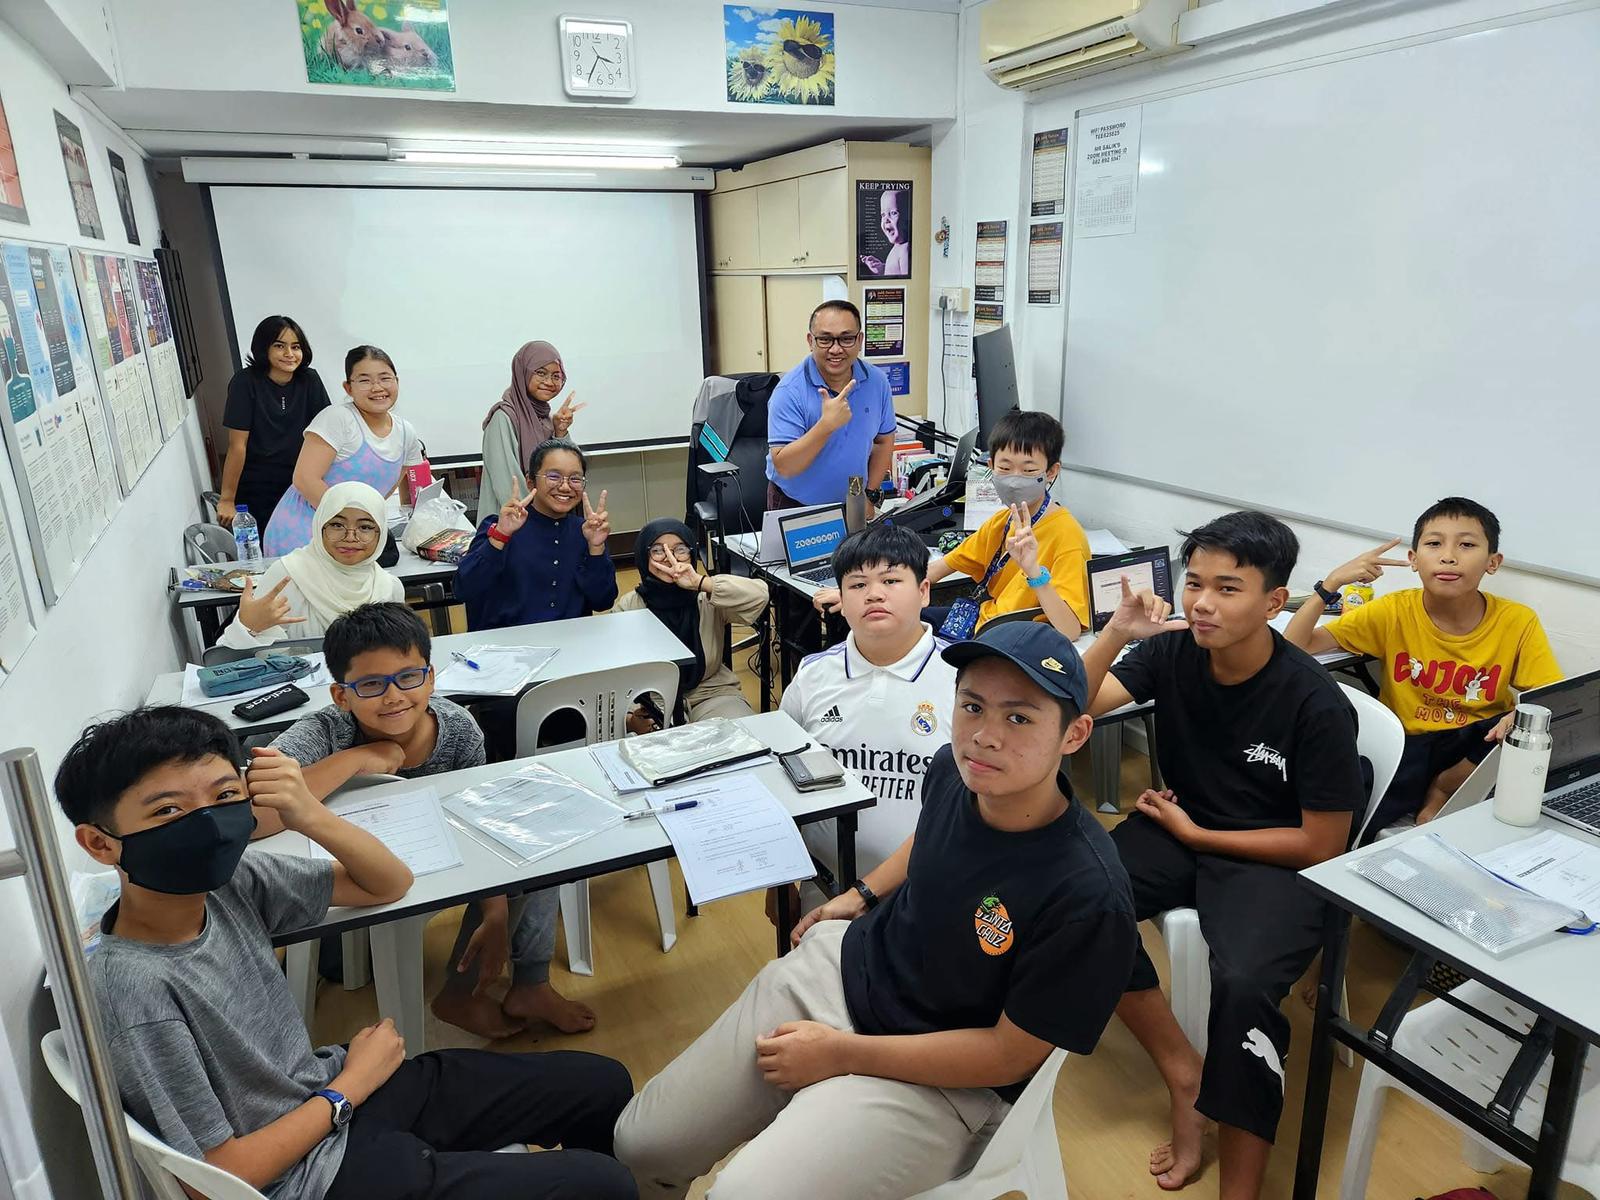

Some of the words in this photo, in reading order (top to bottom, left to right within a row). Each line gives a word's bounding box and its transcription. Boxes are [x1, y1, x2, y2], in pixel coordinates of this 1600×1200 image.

[573, 35, 582, 48] 10
[613, 37, 621, 50] 2
[573, 49, 581, 61] 9
[616, 52, 622, 64] 3
[576, 64, 583, 76] 8
[615, 68, 622, 79] 4
[596, 74, 604, 86] 6
[607, 73, 615, 85] 5
[1100, 122, 1126, 131] PASSWORD
[1087, 152, 1101, 160] ZOOM
[1100, 148, 1122, 157] MEETING
[245, 686, 293, 710] adidas
[1423, 693, 1464, 709] THE
[1415, 706, 1468, 726] MOOD
[820, 743, 933, 776] mirates
[976, 924, 1006, 948] CRUZ
